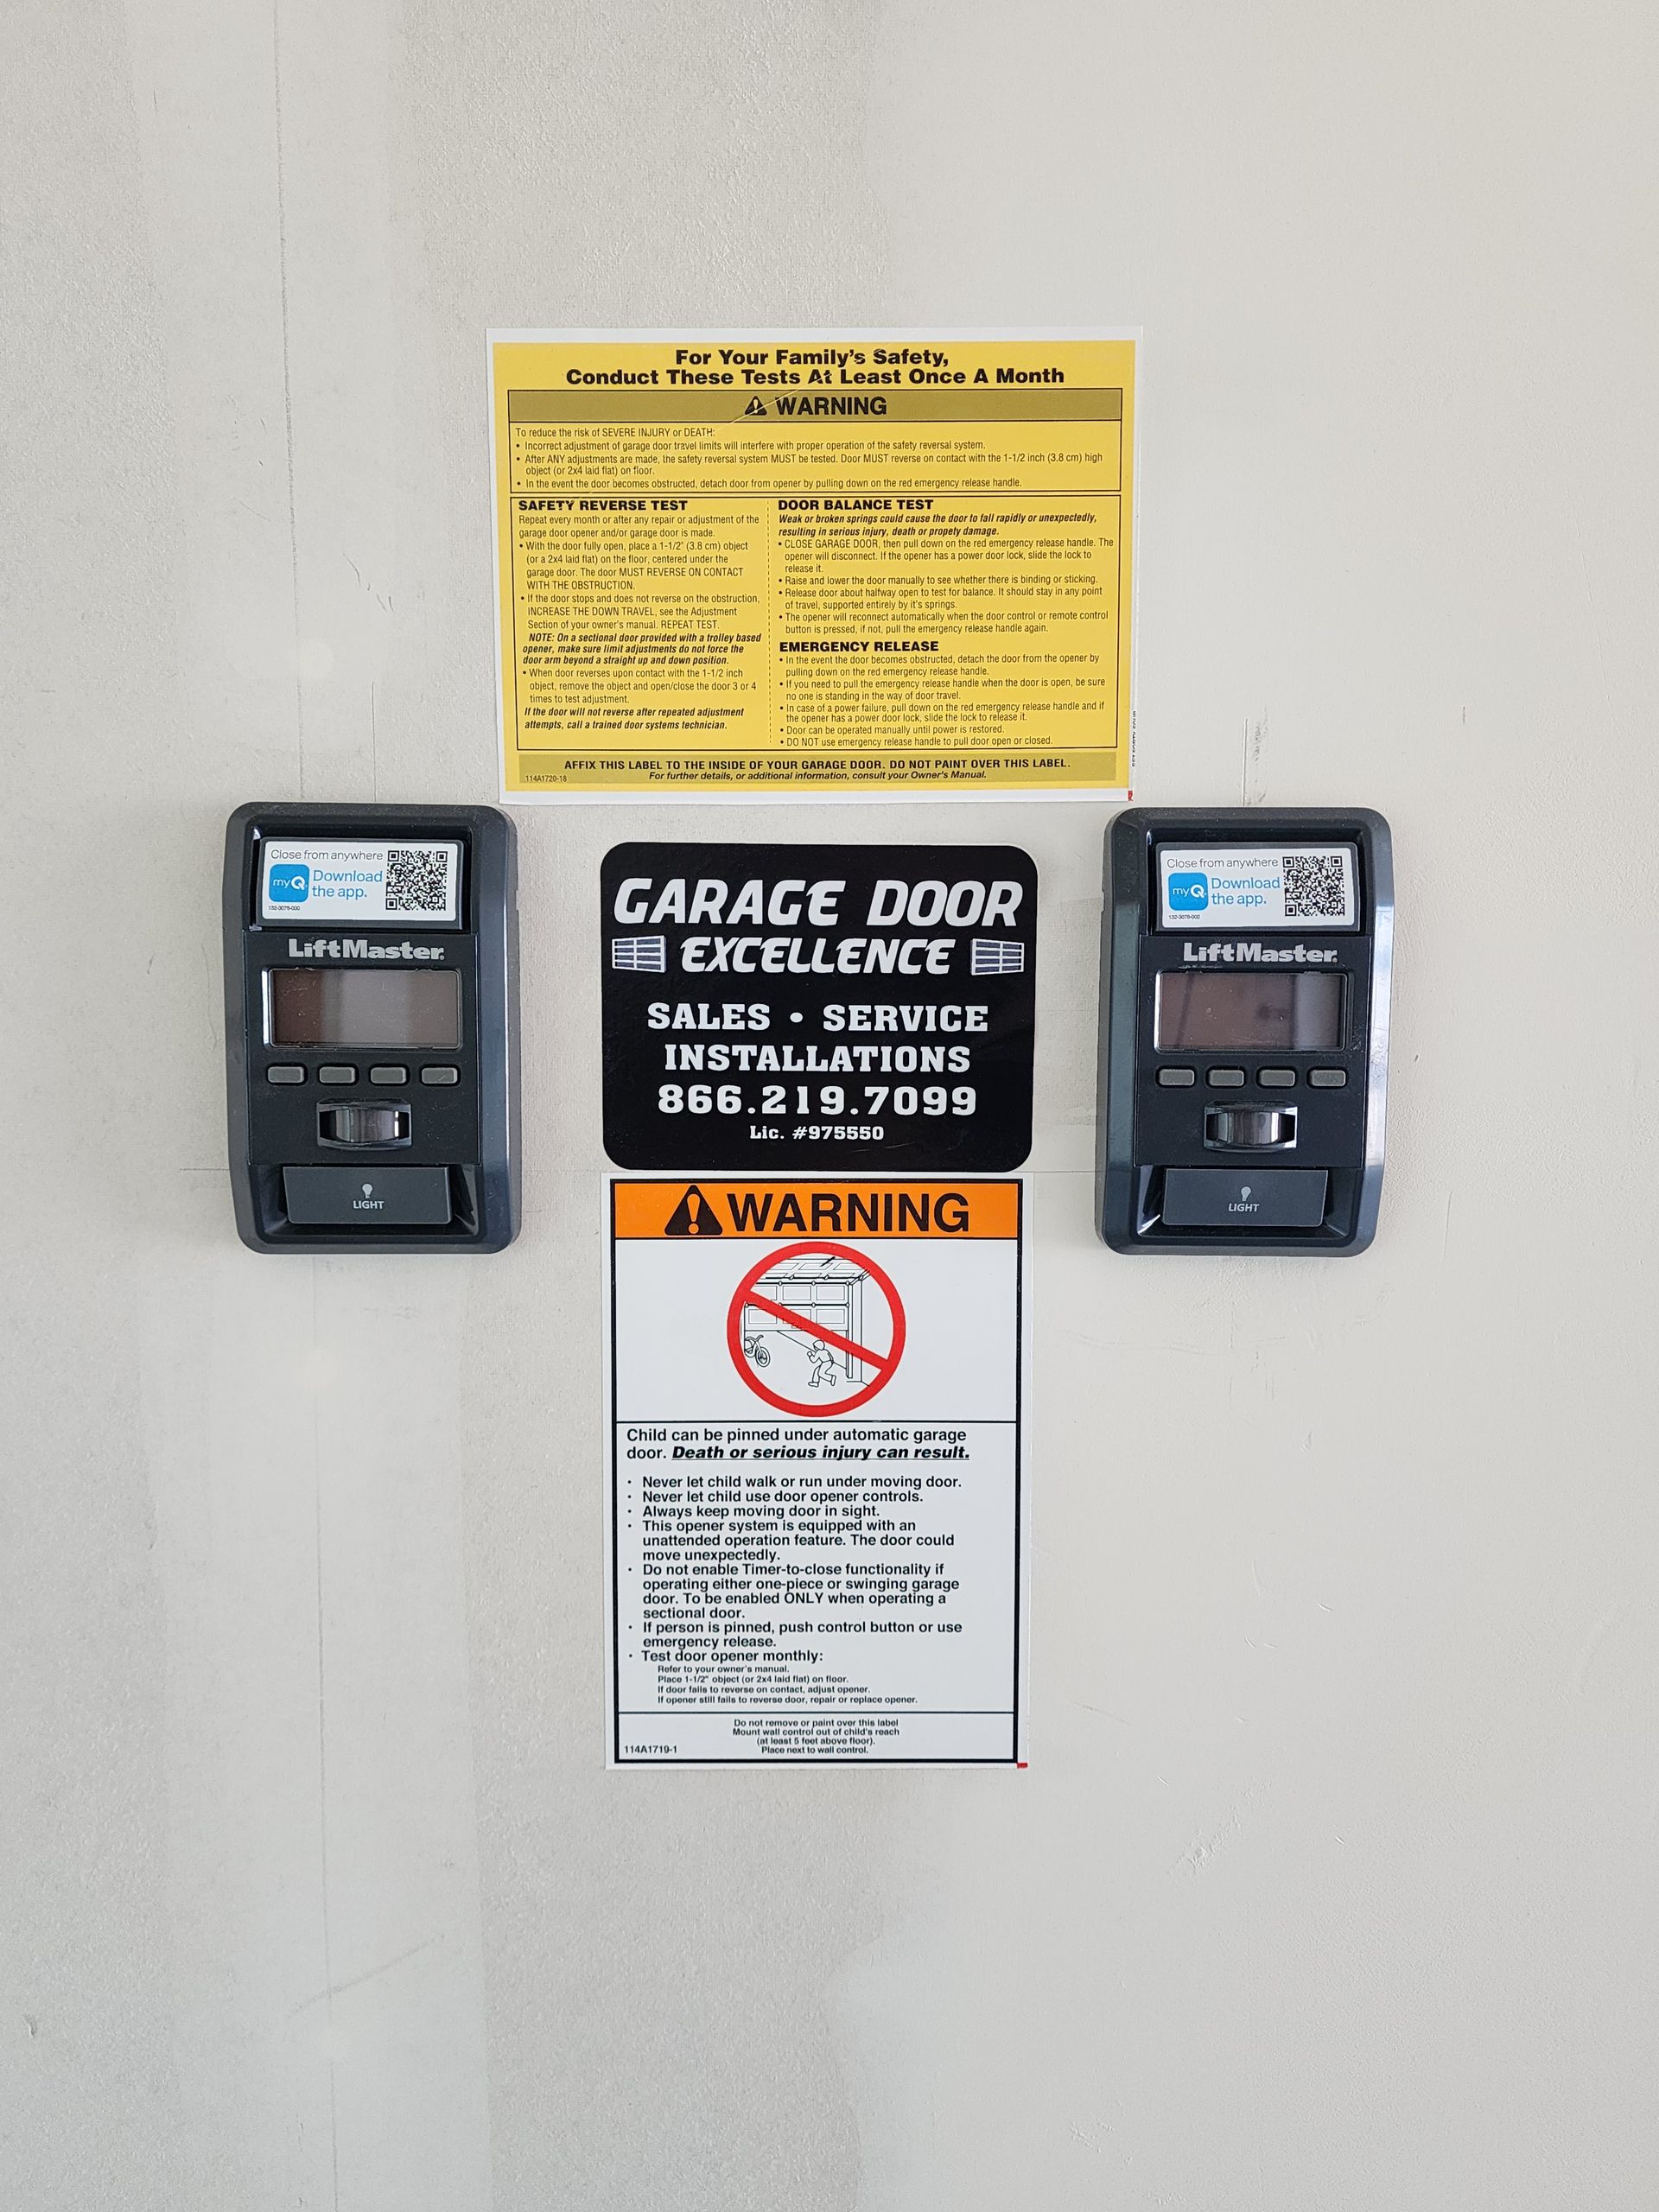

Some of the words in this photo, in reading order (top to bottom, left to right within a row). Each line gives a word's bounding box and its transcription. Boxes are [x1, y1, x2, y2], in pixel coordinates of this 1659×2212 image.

[676, 349, 711, 365] For
[718, 349, 768, 365] Your
[776, 348, 866, 368] Family's
[873, 348, 948, 367] Safety,
[566, 369, 658, 385] Conduct
[665, 369, 734, 385] These
[741, 369, 800, 385] Tests
[807, 369, 832, 384] At
[840, 369, 901, 384] Least
[909, 368, 966, 384] Once
[973, 368, 988, 383] A
[996, 367, 1064, 383] Month
[774, 396, 887, 415] WARNING
[515, 427, 526, 436] To
[529, 428, 556, 437] reduce
[558, 428, 571, 436] the
[574, 428, 589, 437] risk
[591, 428, 600, 436] of
[601, 427, 636, 436] SEVERE
[638, 427, 671, 436] INJURY
[683, 427, 715, 436] DEATH:
[518, 500, 575, 511] SAFETY
[579, 499, 646, 511] REVERSE
[650, 499, 688, 511] TEST
[778, 499, 819, 510] DOOR
[824, 499, 892, 510] BALANCE
[896, 499, 933, 510] TEST
[779, 527, 816, 537] resulting
[818, 527, 826, 536] in
[829, 527, 860, 536] serious
[862, 526, 888, 537] injury,
[892, 526, 916, 536] death
[928, 526, 961, 537] propety
[963, 526, 999, 537] damage.
[526, 580, 550, 589] WITH
[551, 581, 569, 589] THE
[571, 580, 635, 590] OBSTRUCTION.
[785, 575, 807, 585] Raise
[809, 575, 824, 585] and
[827, 575, 849, 585] lower
[851, 575, 864, 585] the
[867, 575, 886, 584] door
[888, 575, 925, 586] manually
[926, 575, 935, 584] to
[953, 575, 986, 584] whether
[988, 575, 1009, 584] there
[1011, 575, 1018, 584] is
[1020, 574, 1051, 585] binding
[1064, 574, 1097, 585] sticking.
[779, 641, 869, 652] EMERGENCY
[874, 640, 938, 652] RELEASE
[564, 760, 596, 769] AFFIX
[599, 760, 625, 769] THIS
[628, 760, 662, 769] LABEL
[665, 760, 680, 769] TO
[683, 760, 705, 769] THE
[709, 760, 745, 769] INSIDE
[749, 760, 763, 769] OF
[766, 760, 798, 769] YOUR
[801, 760, 846, 769] GARAGE
[850, 760, 885, 769] DOOR.
[890, 760, 905, 769] DO
[909, 760, 931, 768] NOT
[935, 760, 967, 768] PAINT
[971, 760, 1000, 768] OVER
[1003, 759, 1028, 767] THIS
[1033, 759, 1070, 767] LABEL.
[700, 772, 733, 781] details,
[795, 771, 849, 780] information,
[852, 771, 886, 779] consult
[950, 770, 986, 779] Manual.
[270, 849, 302, 859] Close
[303, 849, 328, 860] from
[330, 850, 383, 861] anywhere
[1166, 858, 1198, 868] Close
[1199, 858, 1224, 868] from
[1226, 857, 1278, 869] anywhere
[313, 869, 383, 882] Download
[1211, 876, 1281, 889] Download
[311, 886, 334, 897] the
[337, 887, 367, 900] app.
[613, 877, 846, 926] GARAGE
[866, 880, 1023, 926] DOOR
[1211, 893, 1234, 905] the
[1236, 894, 1267, 907] app.
[680, 937, 956, 974] EXCELLENCE
[647, 1002, 770, 1030] SALES
[823, 1004, 988, 1032] SERVICE
[664, 1044, 969, 1072] INSTALLATIONS
[658, 1084, 976, 1116] 866.219.7099
[750, 1125, 785, 1139] Lic.
[791, 1125, 884, 1140] #975550
[353, 1200, 385, 1209] LIGHT
[1229, 1203, 1260, 1211] LIGHT
[726, 1192, 969, 1232] WARNING
[626, 1428, 666, 1441] Child
[671, 1431, 698, 1441] can
[704, 1428, 722, 1441] be
[728, 1427, 779, 1444] pinned
[785, 1427, 829, 1440] under
[833, 1427, 908, 1440] automatic
[913, 1431, 966, 1444] garage
[626, 1446, 666, 1458] door.
[672, 1446, 724, 1458] Death
[729, 1448, 748, 1458] or
[753, 1445, 817, 1458] serious
[822, 1445, 871, 1460] injury
[876, 1448, 908, 1458] can
[914, 1446, 969, 1459] result.
[643, 1476, 683, 1488] Never
[687, 1476, 703, 1487] let
[708, 1475, 741, 1487] child
[745, 1475, 776, 1487] walk
[780, 1478, 795, 1487] or
[799, 1478, 822, 1487] run
[827, 1475, 867, 1487] under
[871, 1475, 921, 1490] moving
[925, 1475, 961, 1487] door.
[641, 1650, 671, 1662] Test
[675, 1649, 707, 1662] door
[710, 1652, 759, 1664] opener
[763, 1649, 823, 1664] monthly:
[695, 1666, 715, 1675] your
[754, 1664, 789, 1673] manual.
[761, 1745, 785, 1754] Place
